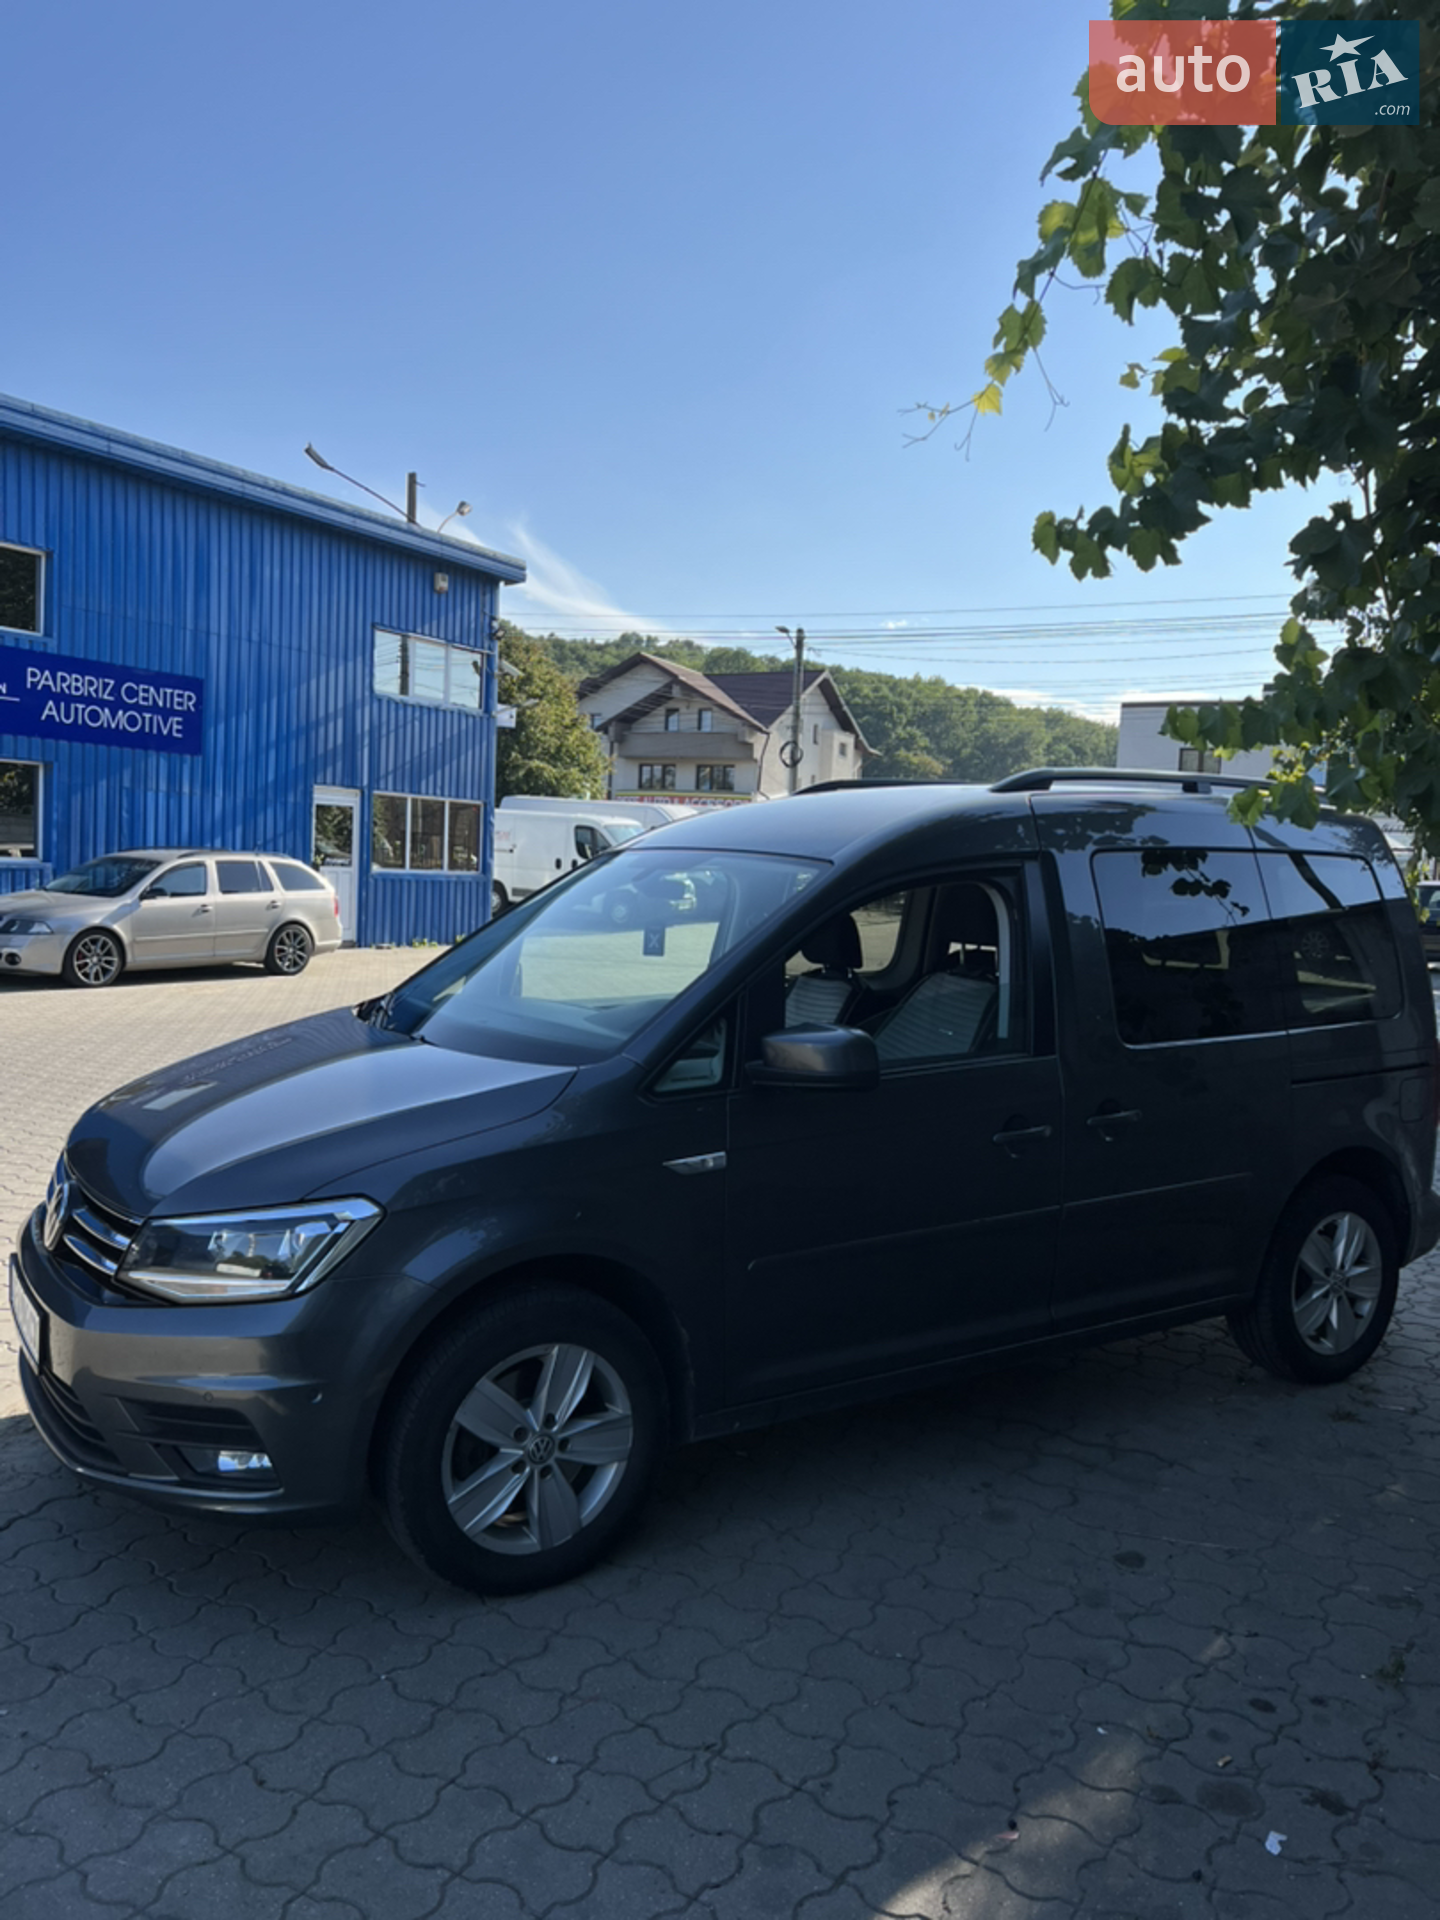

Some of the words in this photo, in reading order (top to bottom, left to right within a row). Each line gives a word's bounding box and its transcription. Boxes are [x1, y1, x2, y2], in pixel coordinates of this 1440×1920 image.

[26, 666, 115, 701] PARBRIZ
[121, 681, 196, 712] CENTER
[40, 699, 183, 738] AUTOMOTIVE
